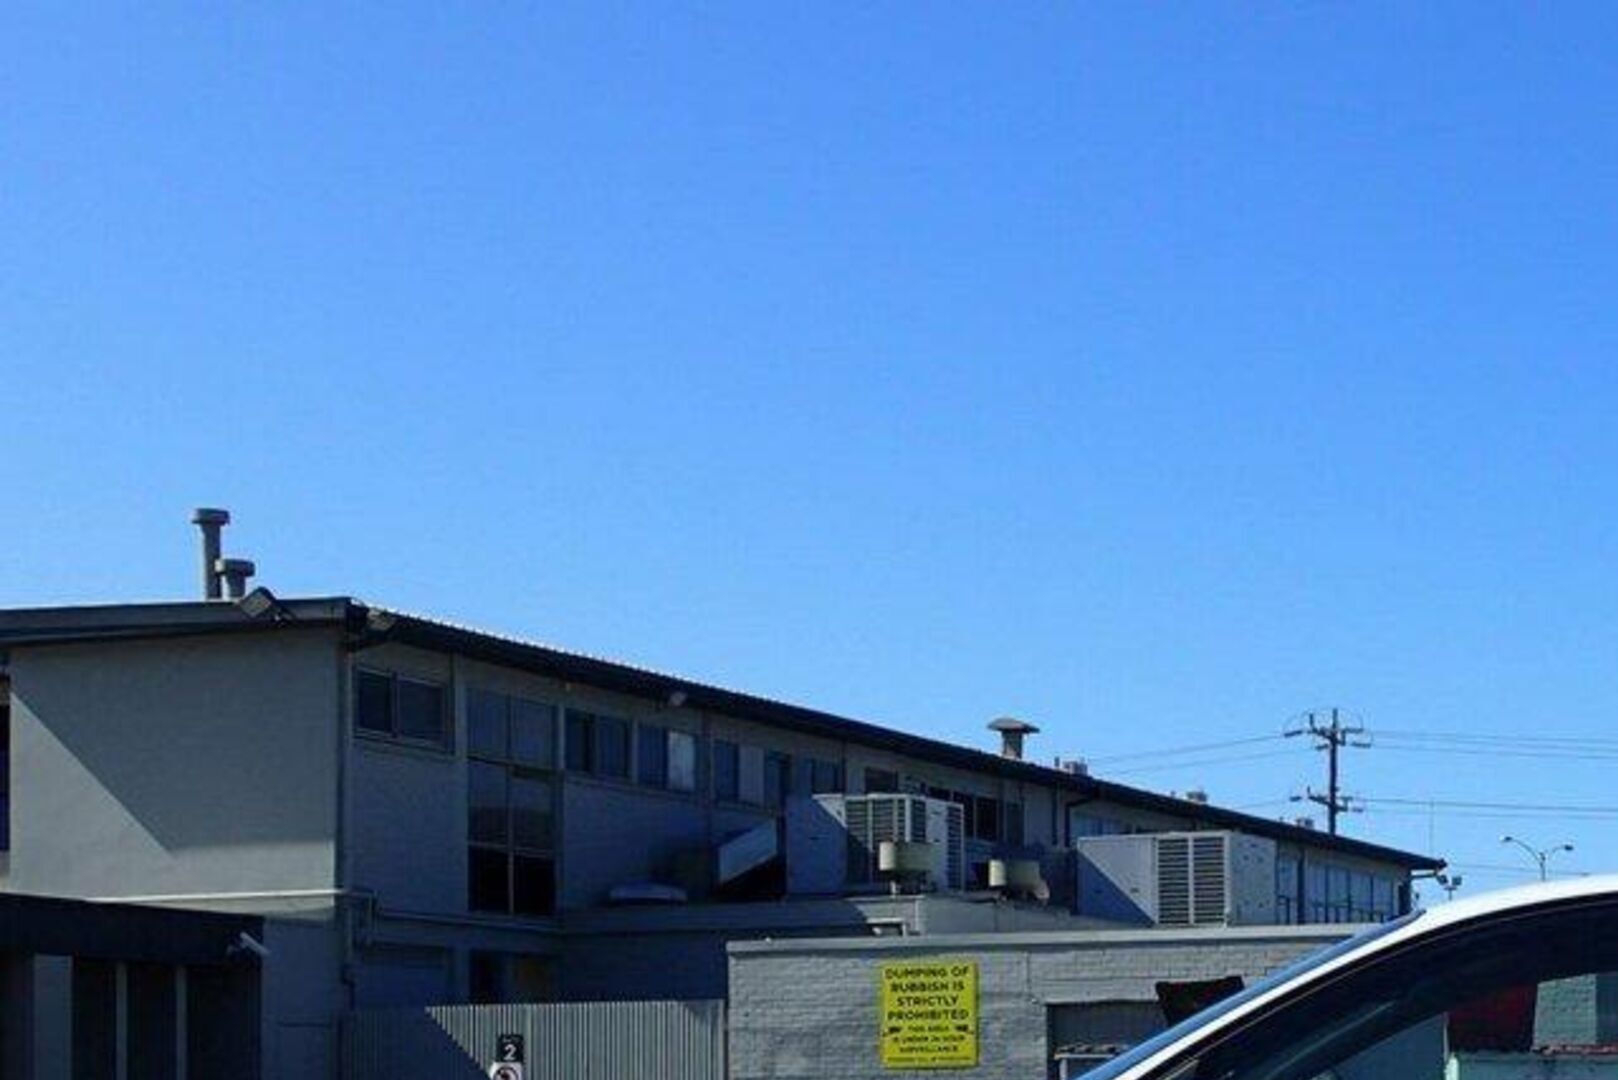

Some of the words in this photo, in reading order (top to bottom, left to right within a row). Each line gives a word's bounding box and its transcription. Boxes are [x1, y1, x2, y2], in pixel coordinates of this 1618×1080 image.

[885, 967, 948, 979] DUMPING
[951, 966, 969, 977] OF
[890, 981, 949, 992] RUBBISH
[953, 980, 965, 991] IS
[896, 995, 959, 1007] STRICTLY
[887, 1008, 969, 1020] PROHIBITED
[503, 1043, 518, 1061] 2
